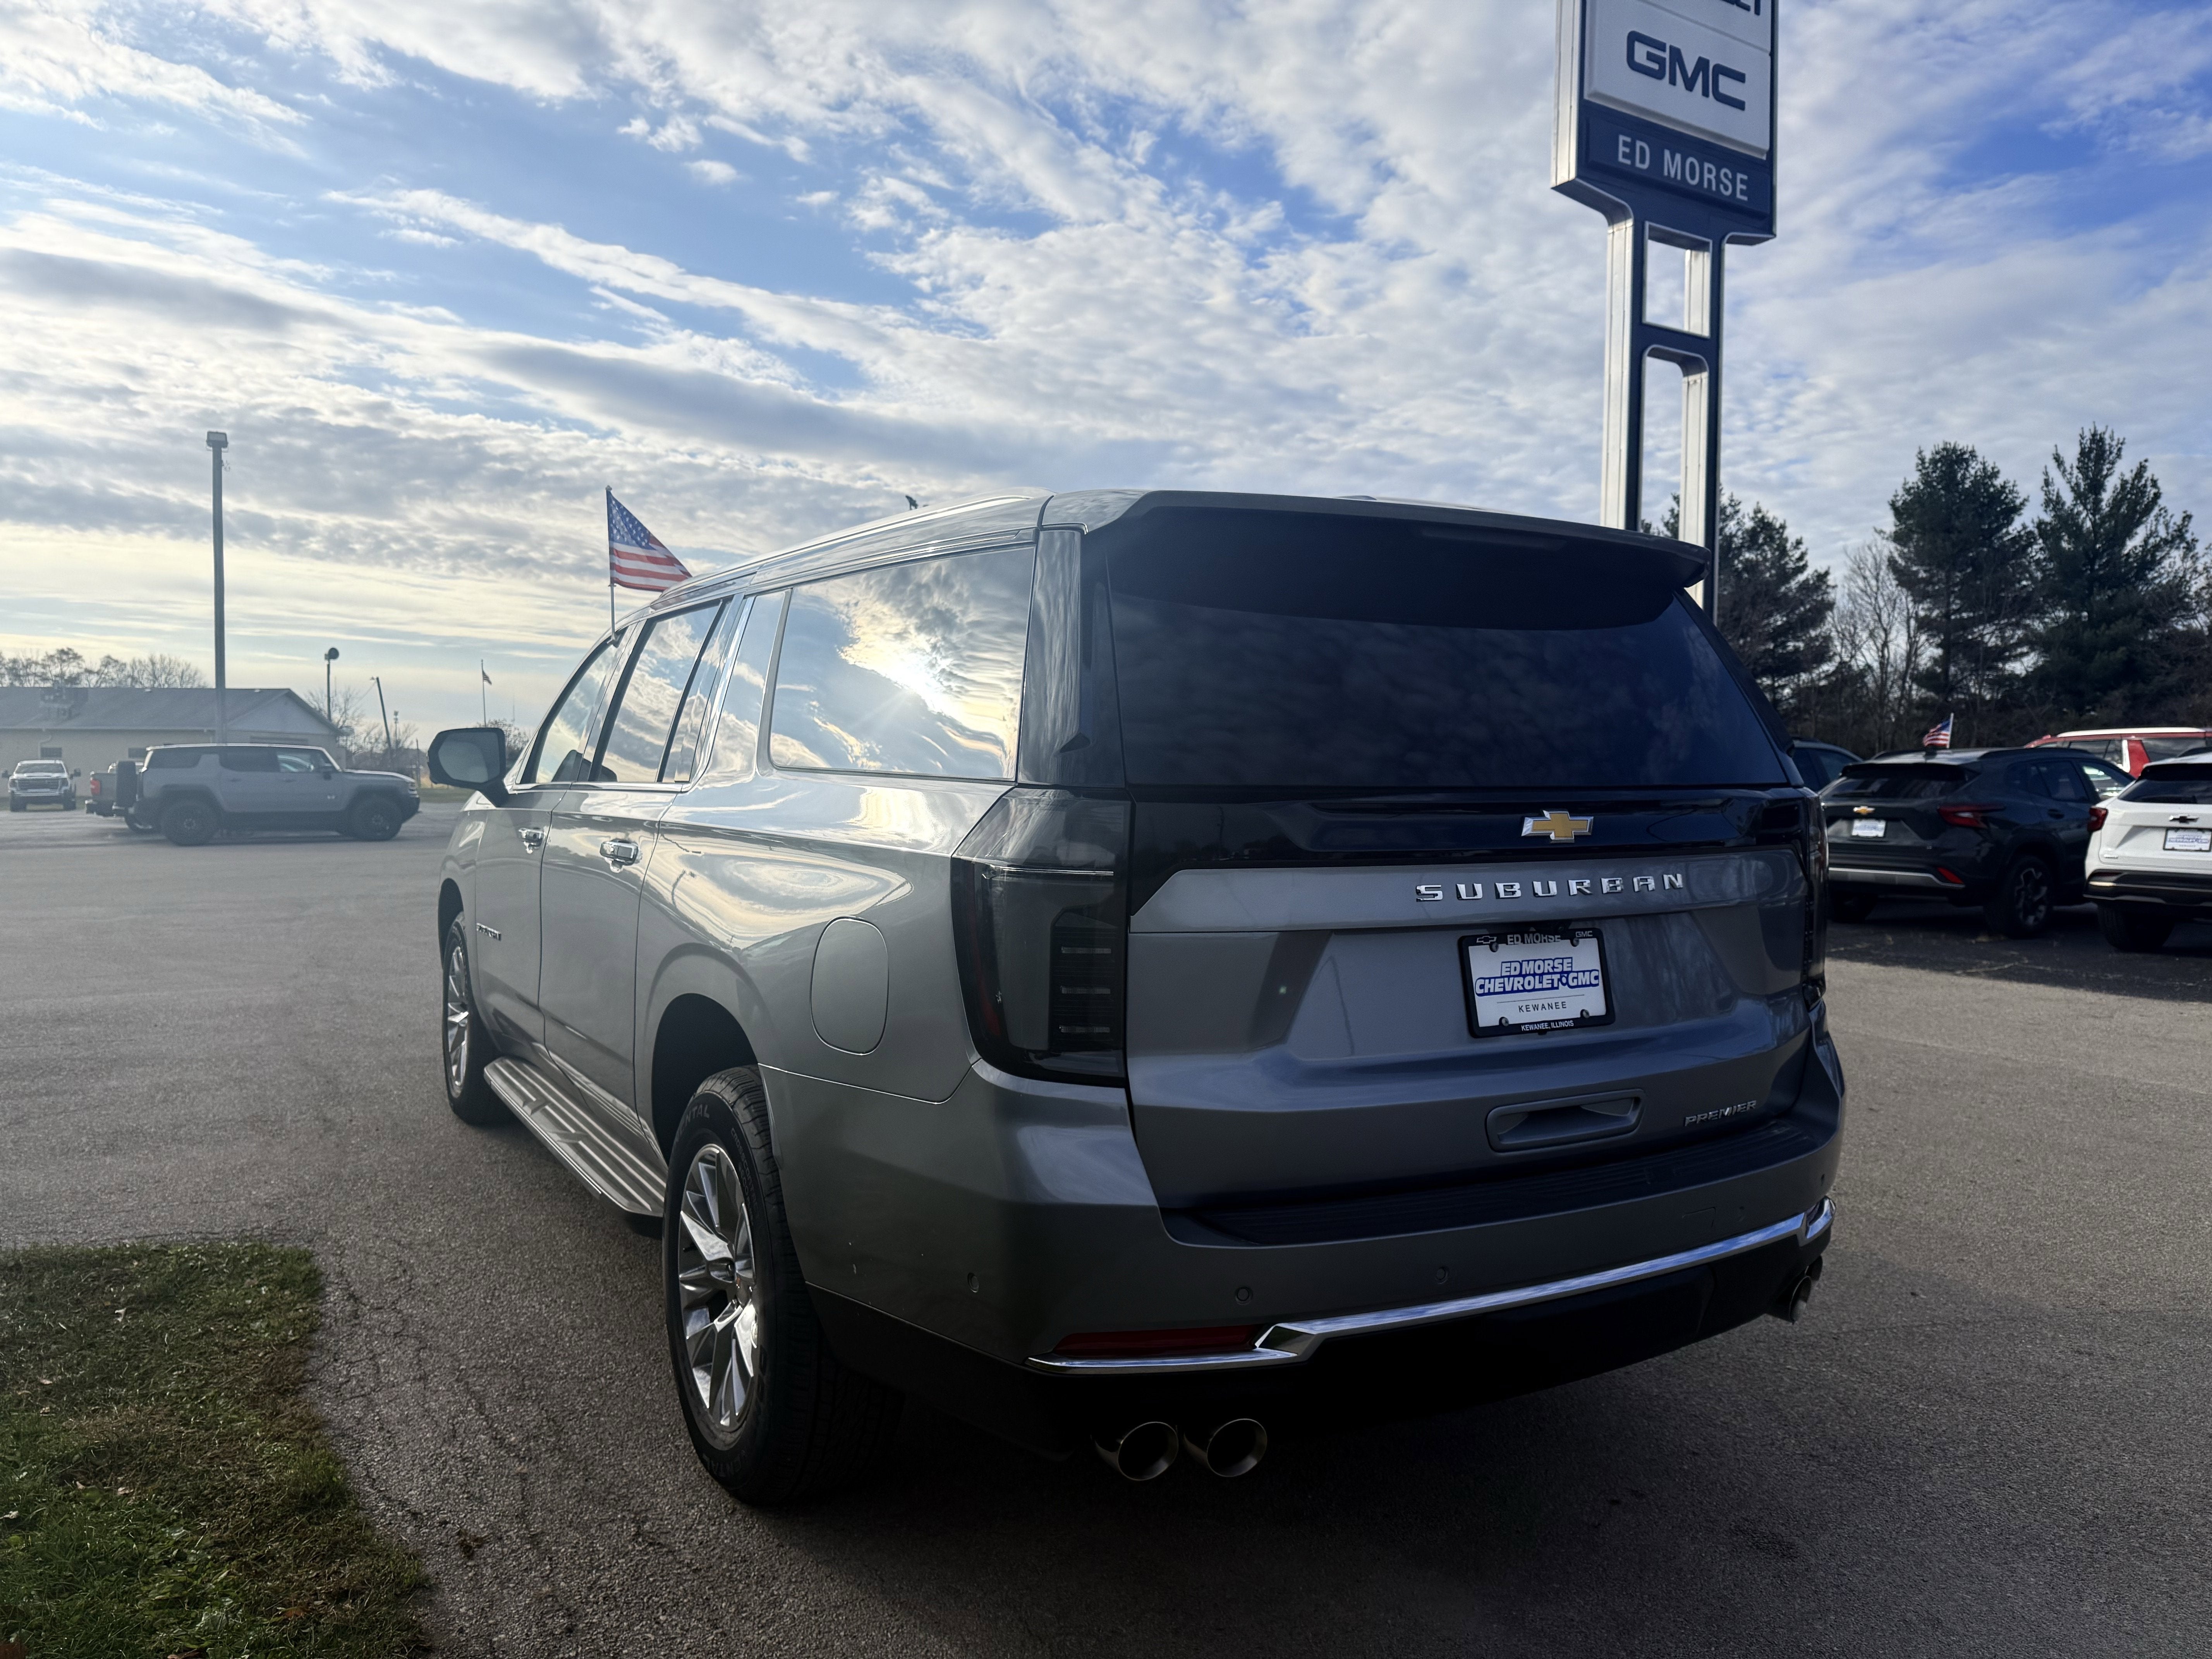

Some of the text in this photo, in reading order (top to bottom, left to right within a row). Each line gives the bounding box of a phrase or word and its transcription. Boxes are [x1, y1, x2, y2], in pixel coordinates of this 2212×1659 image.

[1627, 30, 1745, 111] GMC
[1618, 134, 1748, 201] ED MORSE
[1416, 873, 1683, 902] SUBURBAN
[1507, 934, 1522, 945] ED
[1501, 958, 1572, 975] ED MORSE
[1518, 1001, 1567, 1012] KEWANEE
[1521, 1023, 1551, 1031] KEWANEE,
[1685, 1100, 1756, 1126] PREMIER
